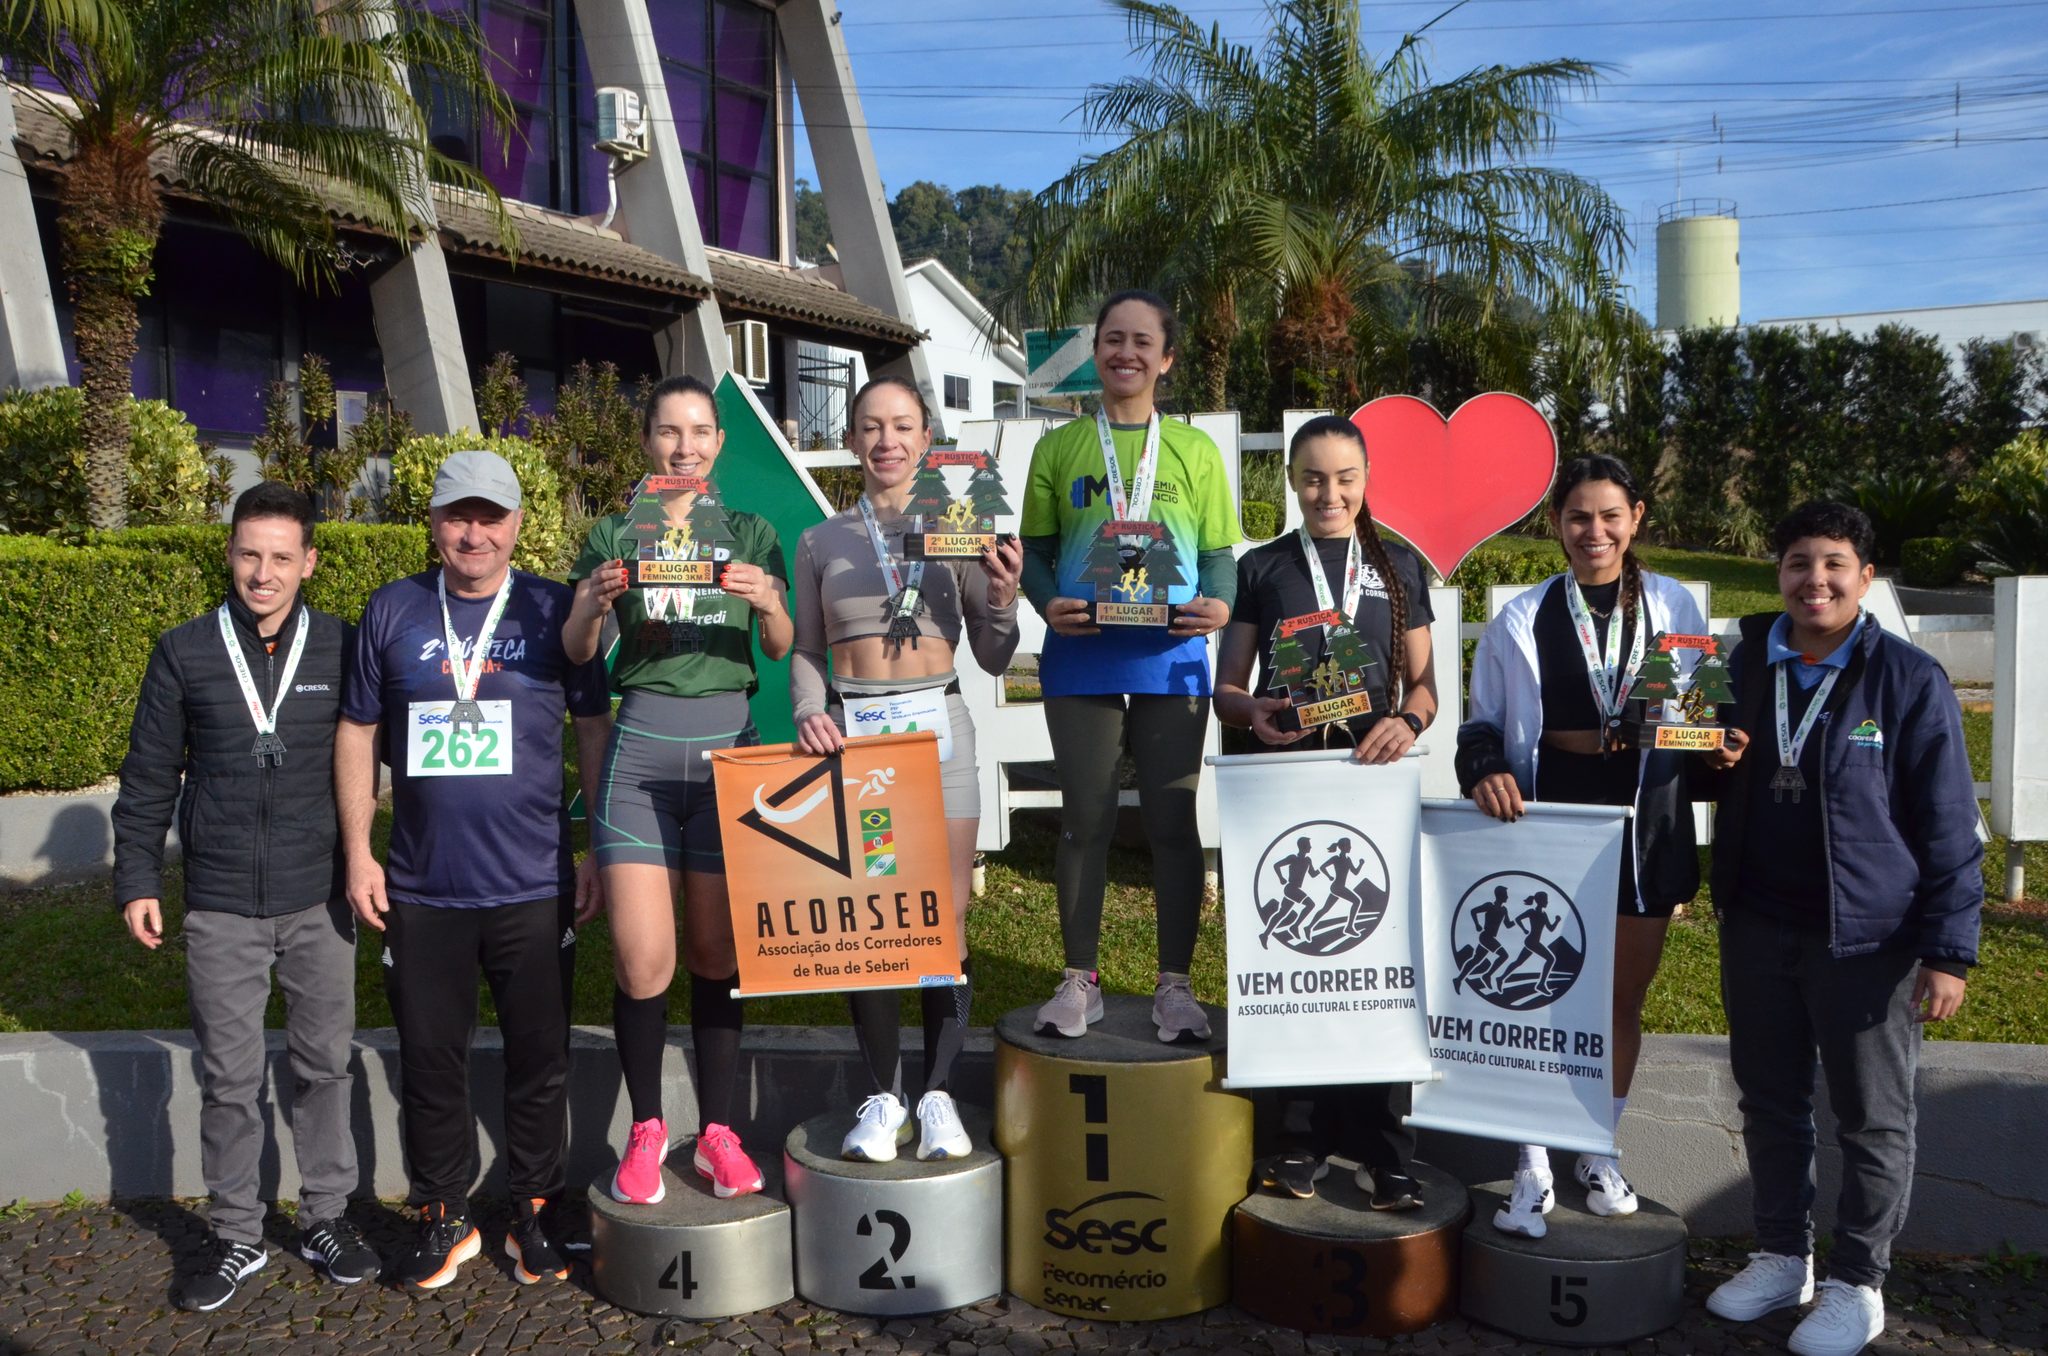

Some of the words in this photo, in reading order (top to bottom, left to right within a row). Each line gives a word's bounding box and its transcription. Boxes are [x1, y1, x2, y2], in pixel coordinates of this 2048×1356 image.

[1109, 456, 1119, 483] CRESOL
[1132, 477, 1143, 508] CRESOL
[931, 537, 942, 545] 2º
[944, 537, 982, 546] LUGAR
[645, 564, 656, 573] 4º
[659, 564, 698, 573] LUGAR
[1100, 615, 1139, 623] FEMININO
[1104, 606, 1113, 614] 1º
[1117, 606, 1153, 615] LUGAR
[480, 631, 493, 660] CRESOL
[1630, 636, 1642, 665] CRESOL
[234, 653, 249, 684] CRESOL
[1592, 663, 1607, 694] CRESOL
[304, 684, 330, 692] CRESOL
[1303, 711, 1342, 726] FEMININO
[1344, 706, 1361, 716] 3KM
[1304, 707, 1315, 717] 3º
[1317, 698, 1355, 714] LUGAR
[421, 728, 499, 769] 262
[1659, 740, 1696, 748] FEMININO
[1663, 730, 1673, 739] 5º
[1676, 731, 1710, 739] LUGAR
[1780, 720, 1789, 754] CRESOL
[757, 890, 940, 938] ACORSEB
[757, 940, 831, 957] Associação
[835, 938, 860, 952] dos
[864, 933, 942, 949] Corredores
[793, 964, 810, 978] de
[814, 963, 840, 976] Rua
[844, 961, 861, 974] de
[866, 958, 910, 973] Seberi
[1237, 972, 1284, 996] VEM
[1290, 967, 1378, 994] CORRER
[1385, 966, 1416, 989] RB
[1238, 1001, 1299, 1017] ASSOCIAÇÃO
[1302, 1001, 1350, 1014] CULTURAL
[1353, 1001, 1359, 1011] E
[1362, 998, 1416, 1011] ESPORTIVA
[1427, 1015, 1473, 1042] VEM
[1479, 1020, 1567, 1054] CORRER
[1574, 1031, 1604, 1058] RB
[1489, 1054, 1537, 1071] CULTURAL
[1539, 1061, 1545, 1072] E
[1548, 1061, 1603, 1080] ESPORTIVA
[1069, 1074, 1109, 1181] 1
[1043, 1208, 1168, 1255] Sesc
[856, 1210, 917, 1290] 2
[658, 1250, 698, 1300] 4
[1043, 1262, 1167, 1289] Fecomércio
[1313, 1248, 1367, 1330] 3
[1043, 1287, 1107, 1313] Senac
[1550, 1274, 1588, 1328] 5
